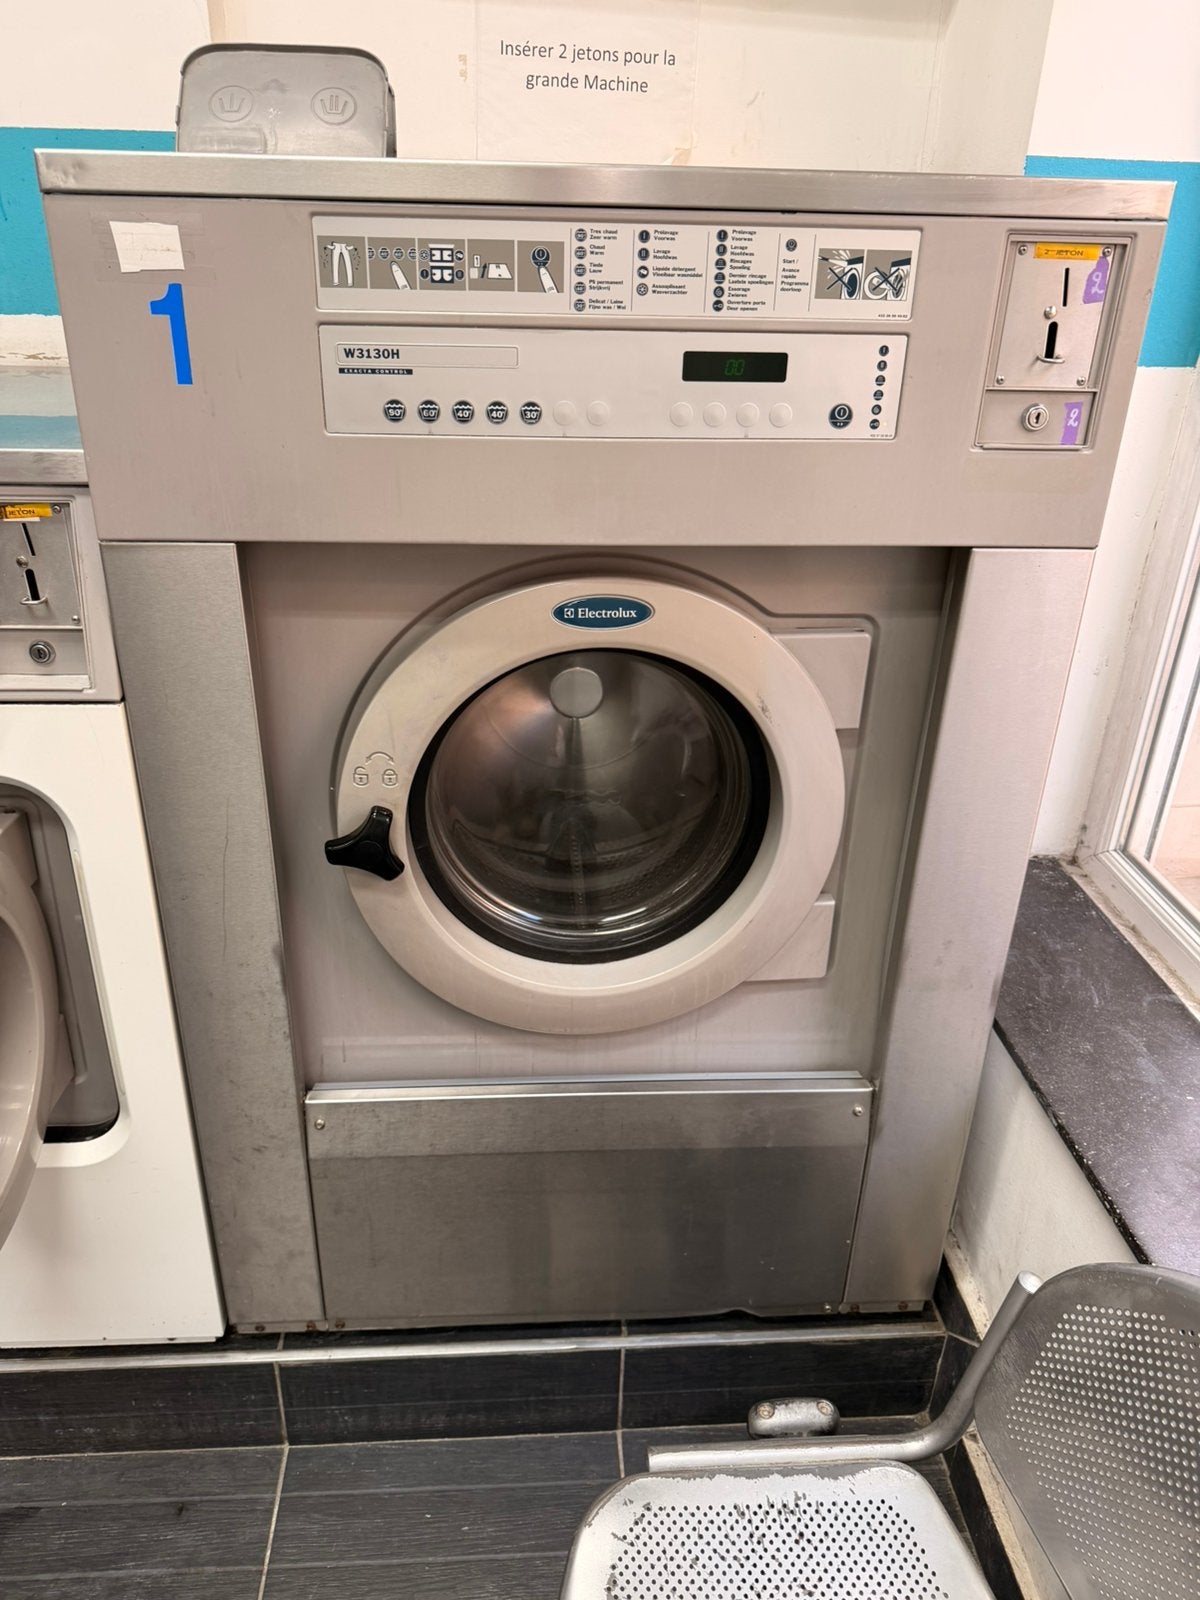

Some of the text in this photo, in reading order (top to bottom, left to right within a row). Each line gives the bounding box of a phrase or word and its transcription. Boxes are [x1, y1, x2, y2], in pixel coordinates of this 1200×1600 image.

[500, 40, 676, 66] Insérer 2 jetons pour la
[525, 72, 649, 93] grande Machine
[149, 282, 194, 386] 1
[343, 347, 400, 360] W3130H
[577, 607, 637, 619] Electrolux
